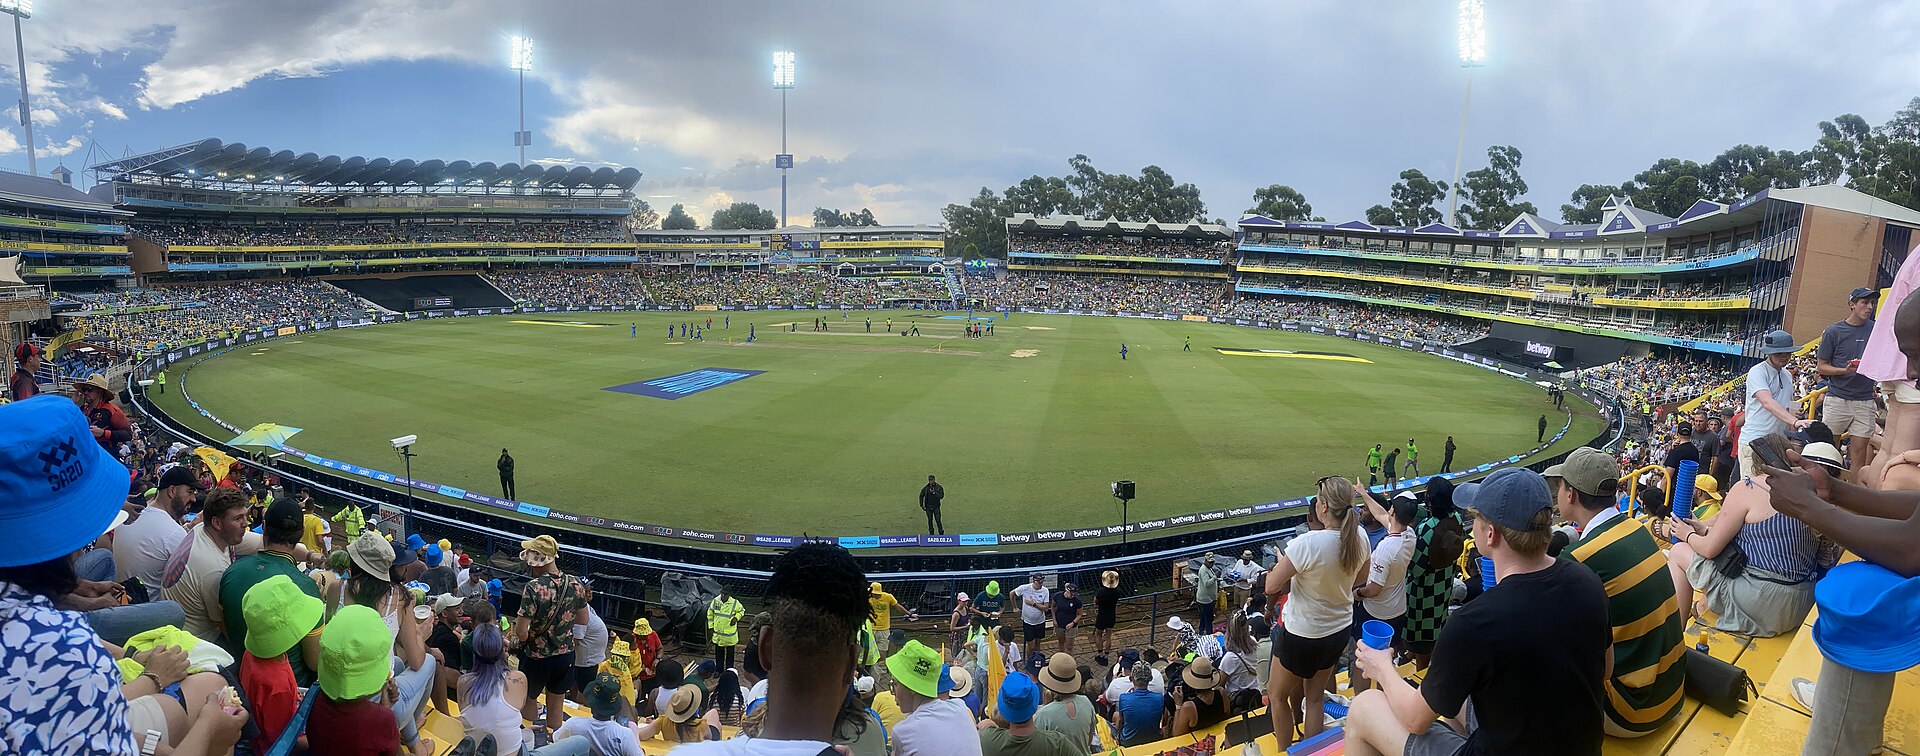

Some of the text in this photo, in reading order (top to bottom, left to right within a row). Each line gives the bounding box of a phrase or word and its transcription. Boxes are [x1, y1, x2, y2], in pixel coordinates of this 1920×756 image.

[1526, 340, 1553, 358] betway
[1731, 374, 1748, 388] JOBU
[38, 435, 78, 474] XX
[48, 460, 83, 492] SA20
[549, 511, 578, 522] zoho.com
[1200, 511, 1225, 521] betway
[1229, 506, 1252, 517] betway
[1139, 519, 1166, 529] betway
[1171, 514, 1196, 525] betway
[613, 522, 644, 531] zoho.com
[1107, 524, 1134, 533] betway
[682, 529, 715, 540] zoho.com
[1000, 533, 1030, 542] betway
[1037, 530, 1067, 540] betway
[1073, 528, 1102, 538] betway
[917, 658, 931, 670] XX
[913, 665, 928, 676] SA20
